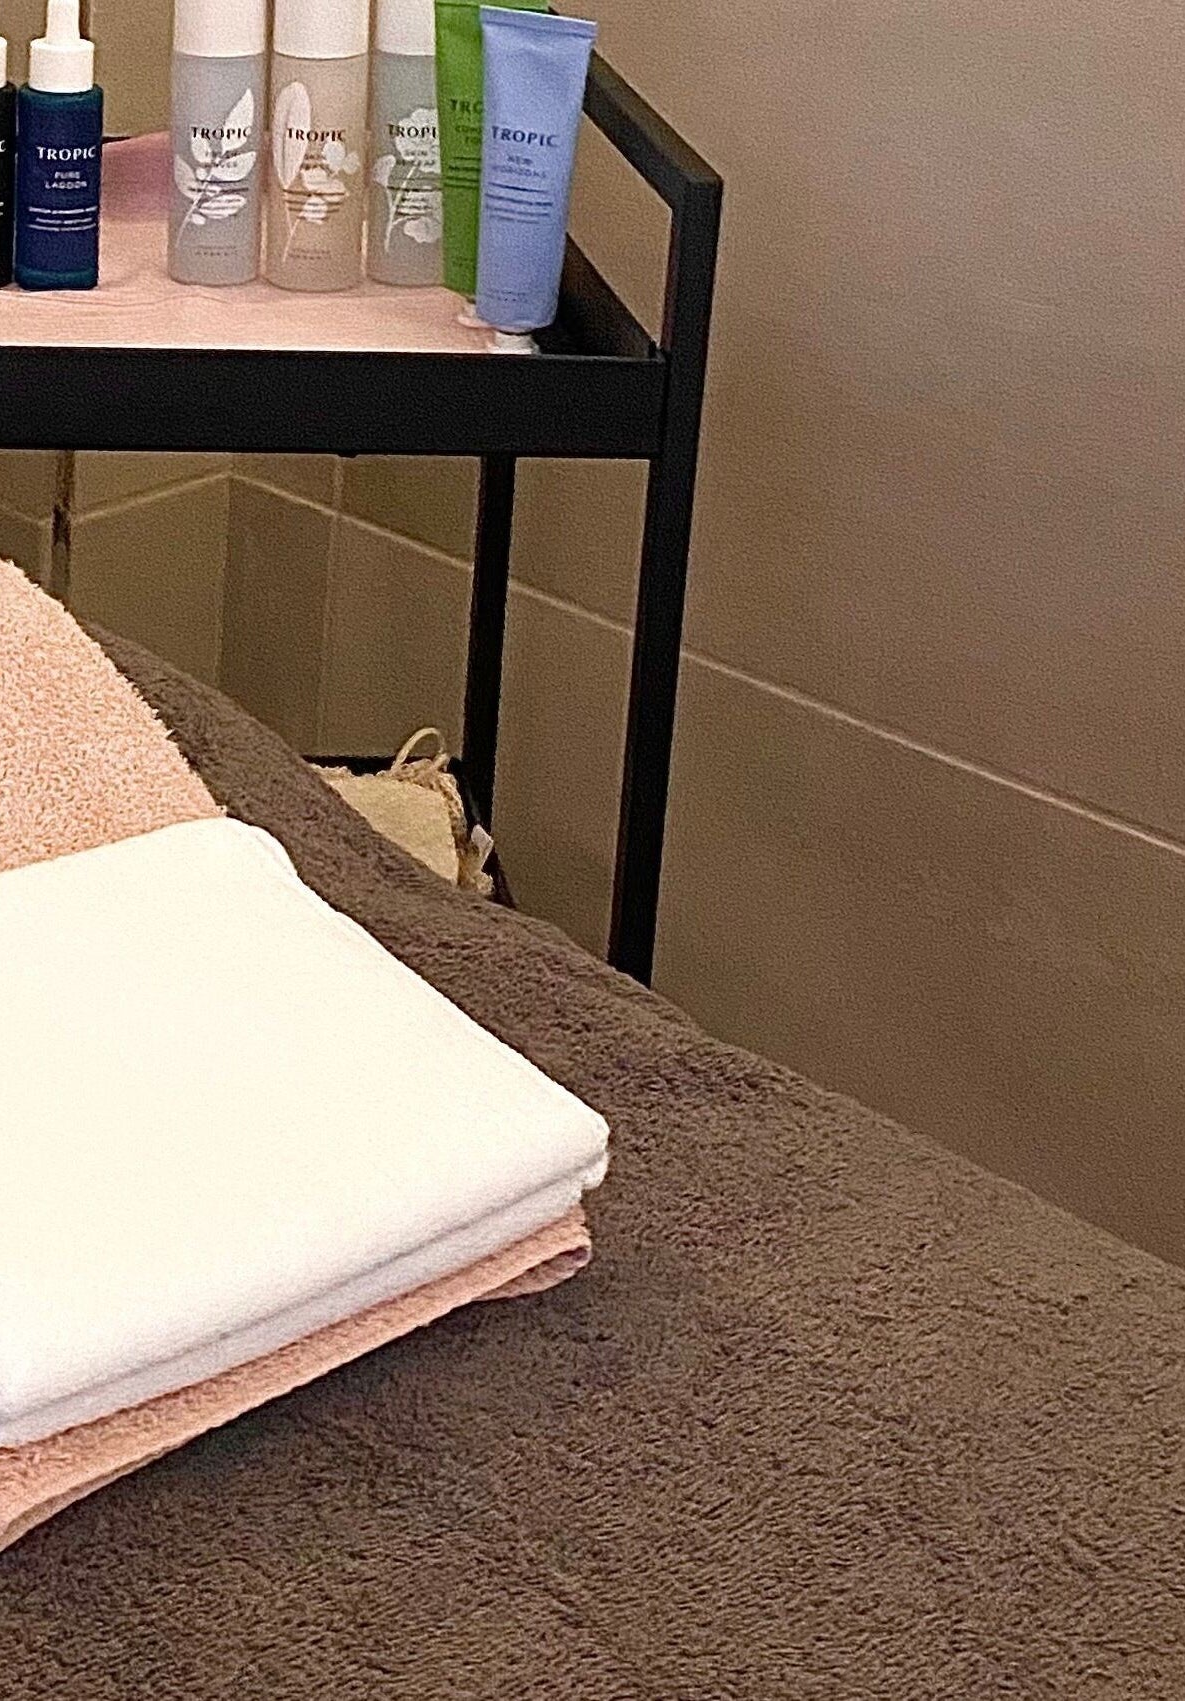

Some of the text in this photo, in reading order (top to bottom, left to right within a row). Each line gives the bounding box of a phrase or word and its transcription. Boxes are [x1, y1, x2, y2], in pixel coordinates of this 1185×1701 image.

[451, 99, 482, 114] TRO
[191, 126, 252, 140] TROPIC
[286, 127, 346, 142] TROPIC
[388, 124, 437, 139] TROPI
[491, 125, 559, 148] TROPIC
[36, 145, 97, 161] TROPIC
[54, 171, 81, 179] PURE
[45, 180, 88, 190] LAGOON
